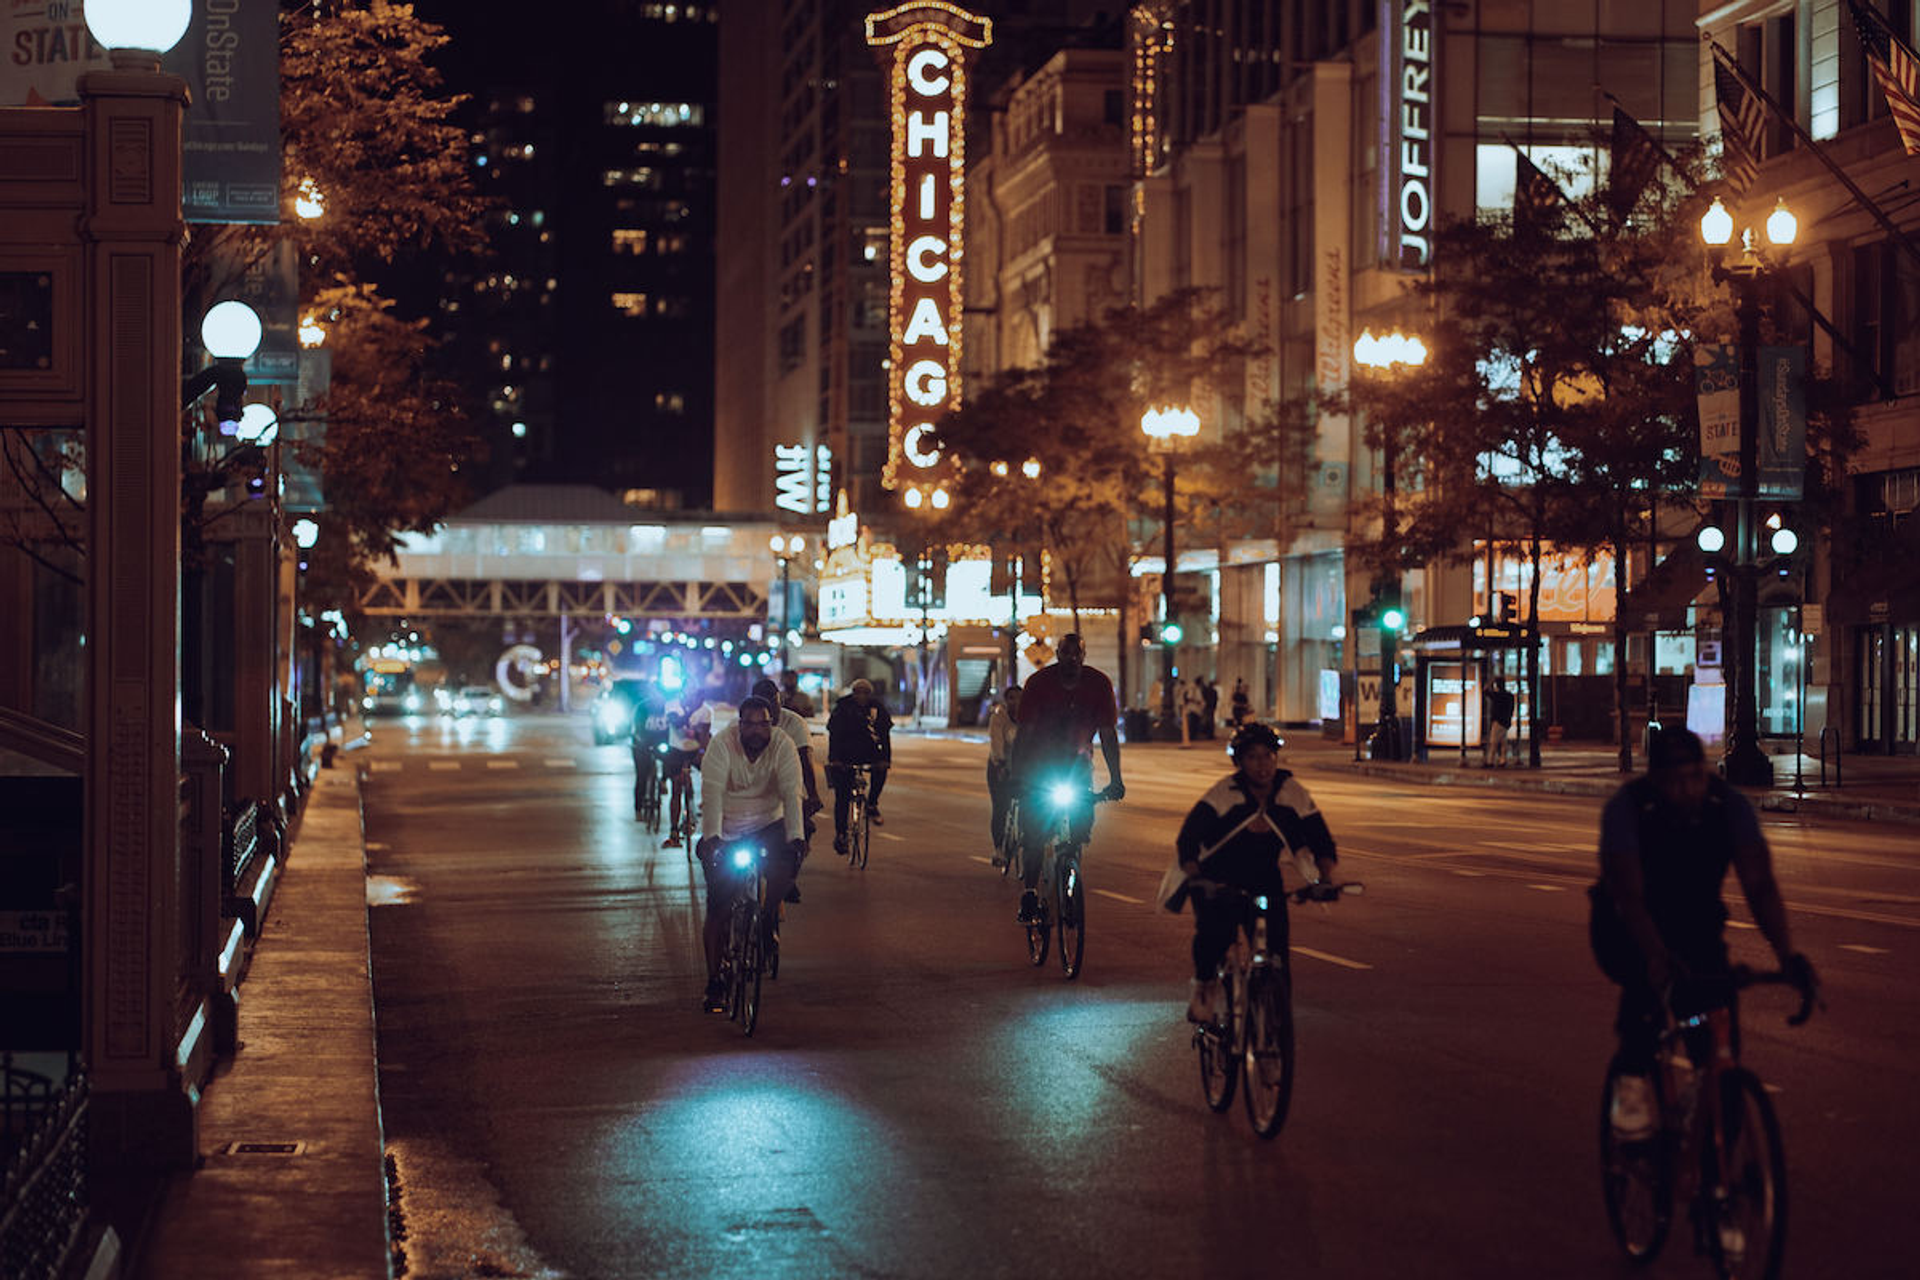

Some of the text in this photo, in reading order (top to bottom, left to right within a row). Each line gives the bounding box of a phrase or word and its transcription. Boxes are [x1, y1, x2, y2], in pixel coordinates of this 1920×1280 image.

[48, 2, 69, 20] ON
[1401, 0, 1430, 266] JOFFREY
[903, 49, 950, 469] CHICAGO
[1706, 422, 1738, 440] STATE
[43, 931, 66, 948] Lin
